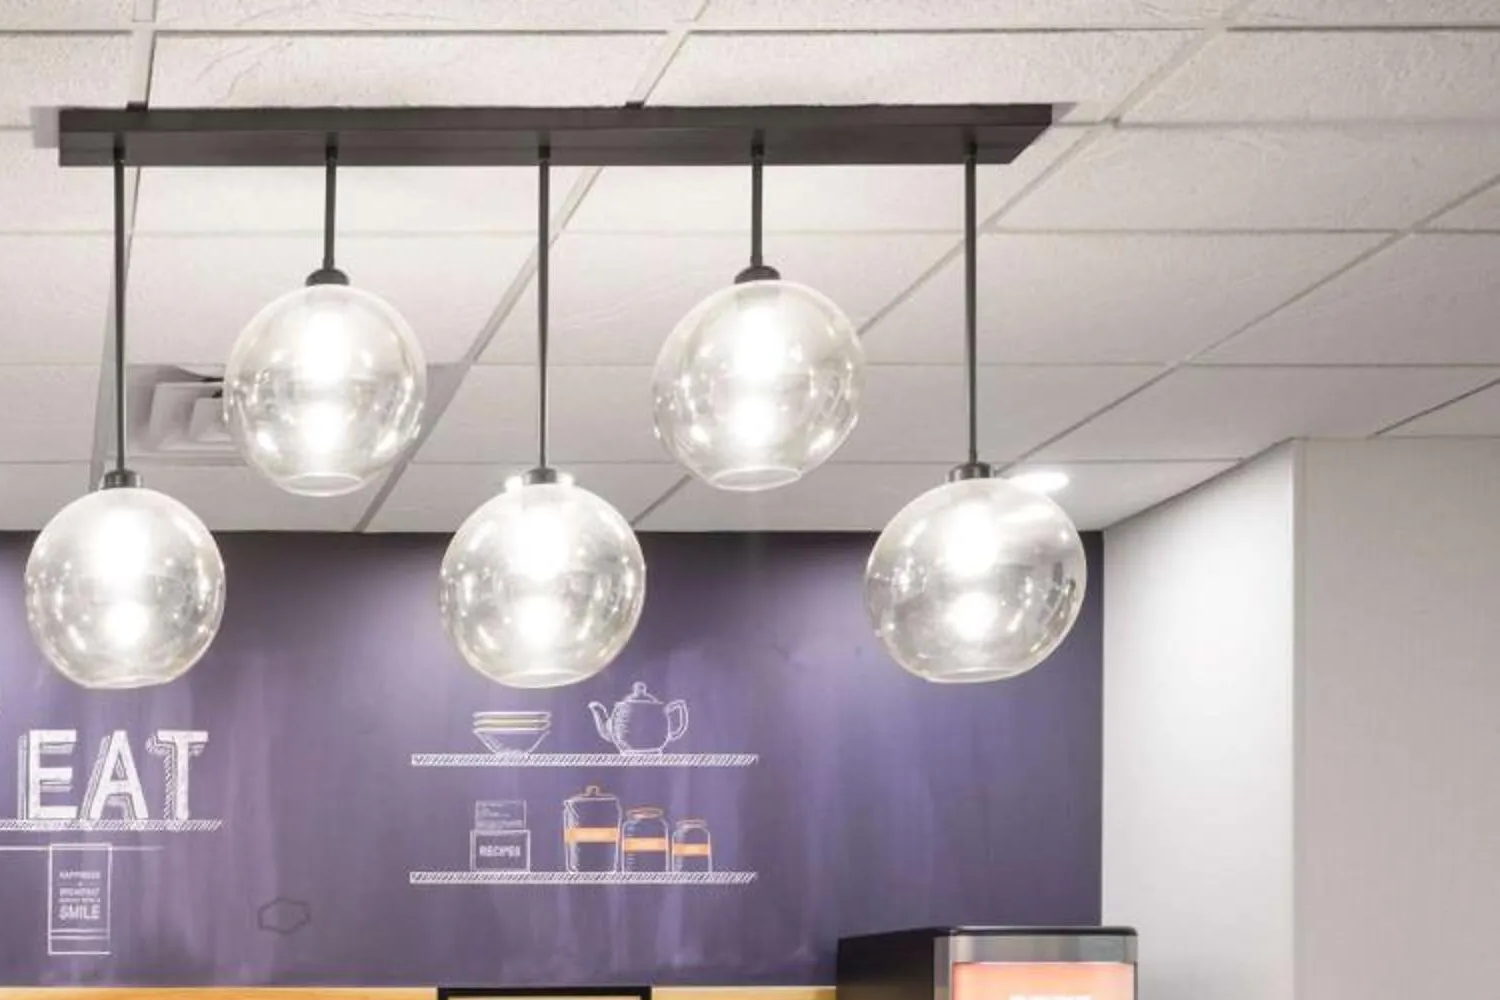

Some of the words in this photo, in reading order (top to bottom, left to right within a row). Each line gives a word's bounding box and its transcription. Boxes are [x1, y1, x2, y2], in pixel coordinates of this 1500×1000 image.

[18, 729, 209, 820] EAT
[479, 845, 521, 857] RECIPES
[58, 903, 100, 920] SMILE
